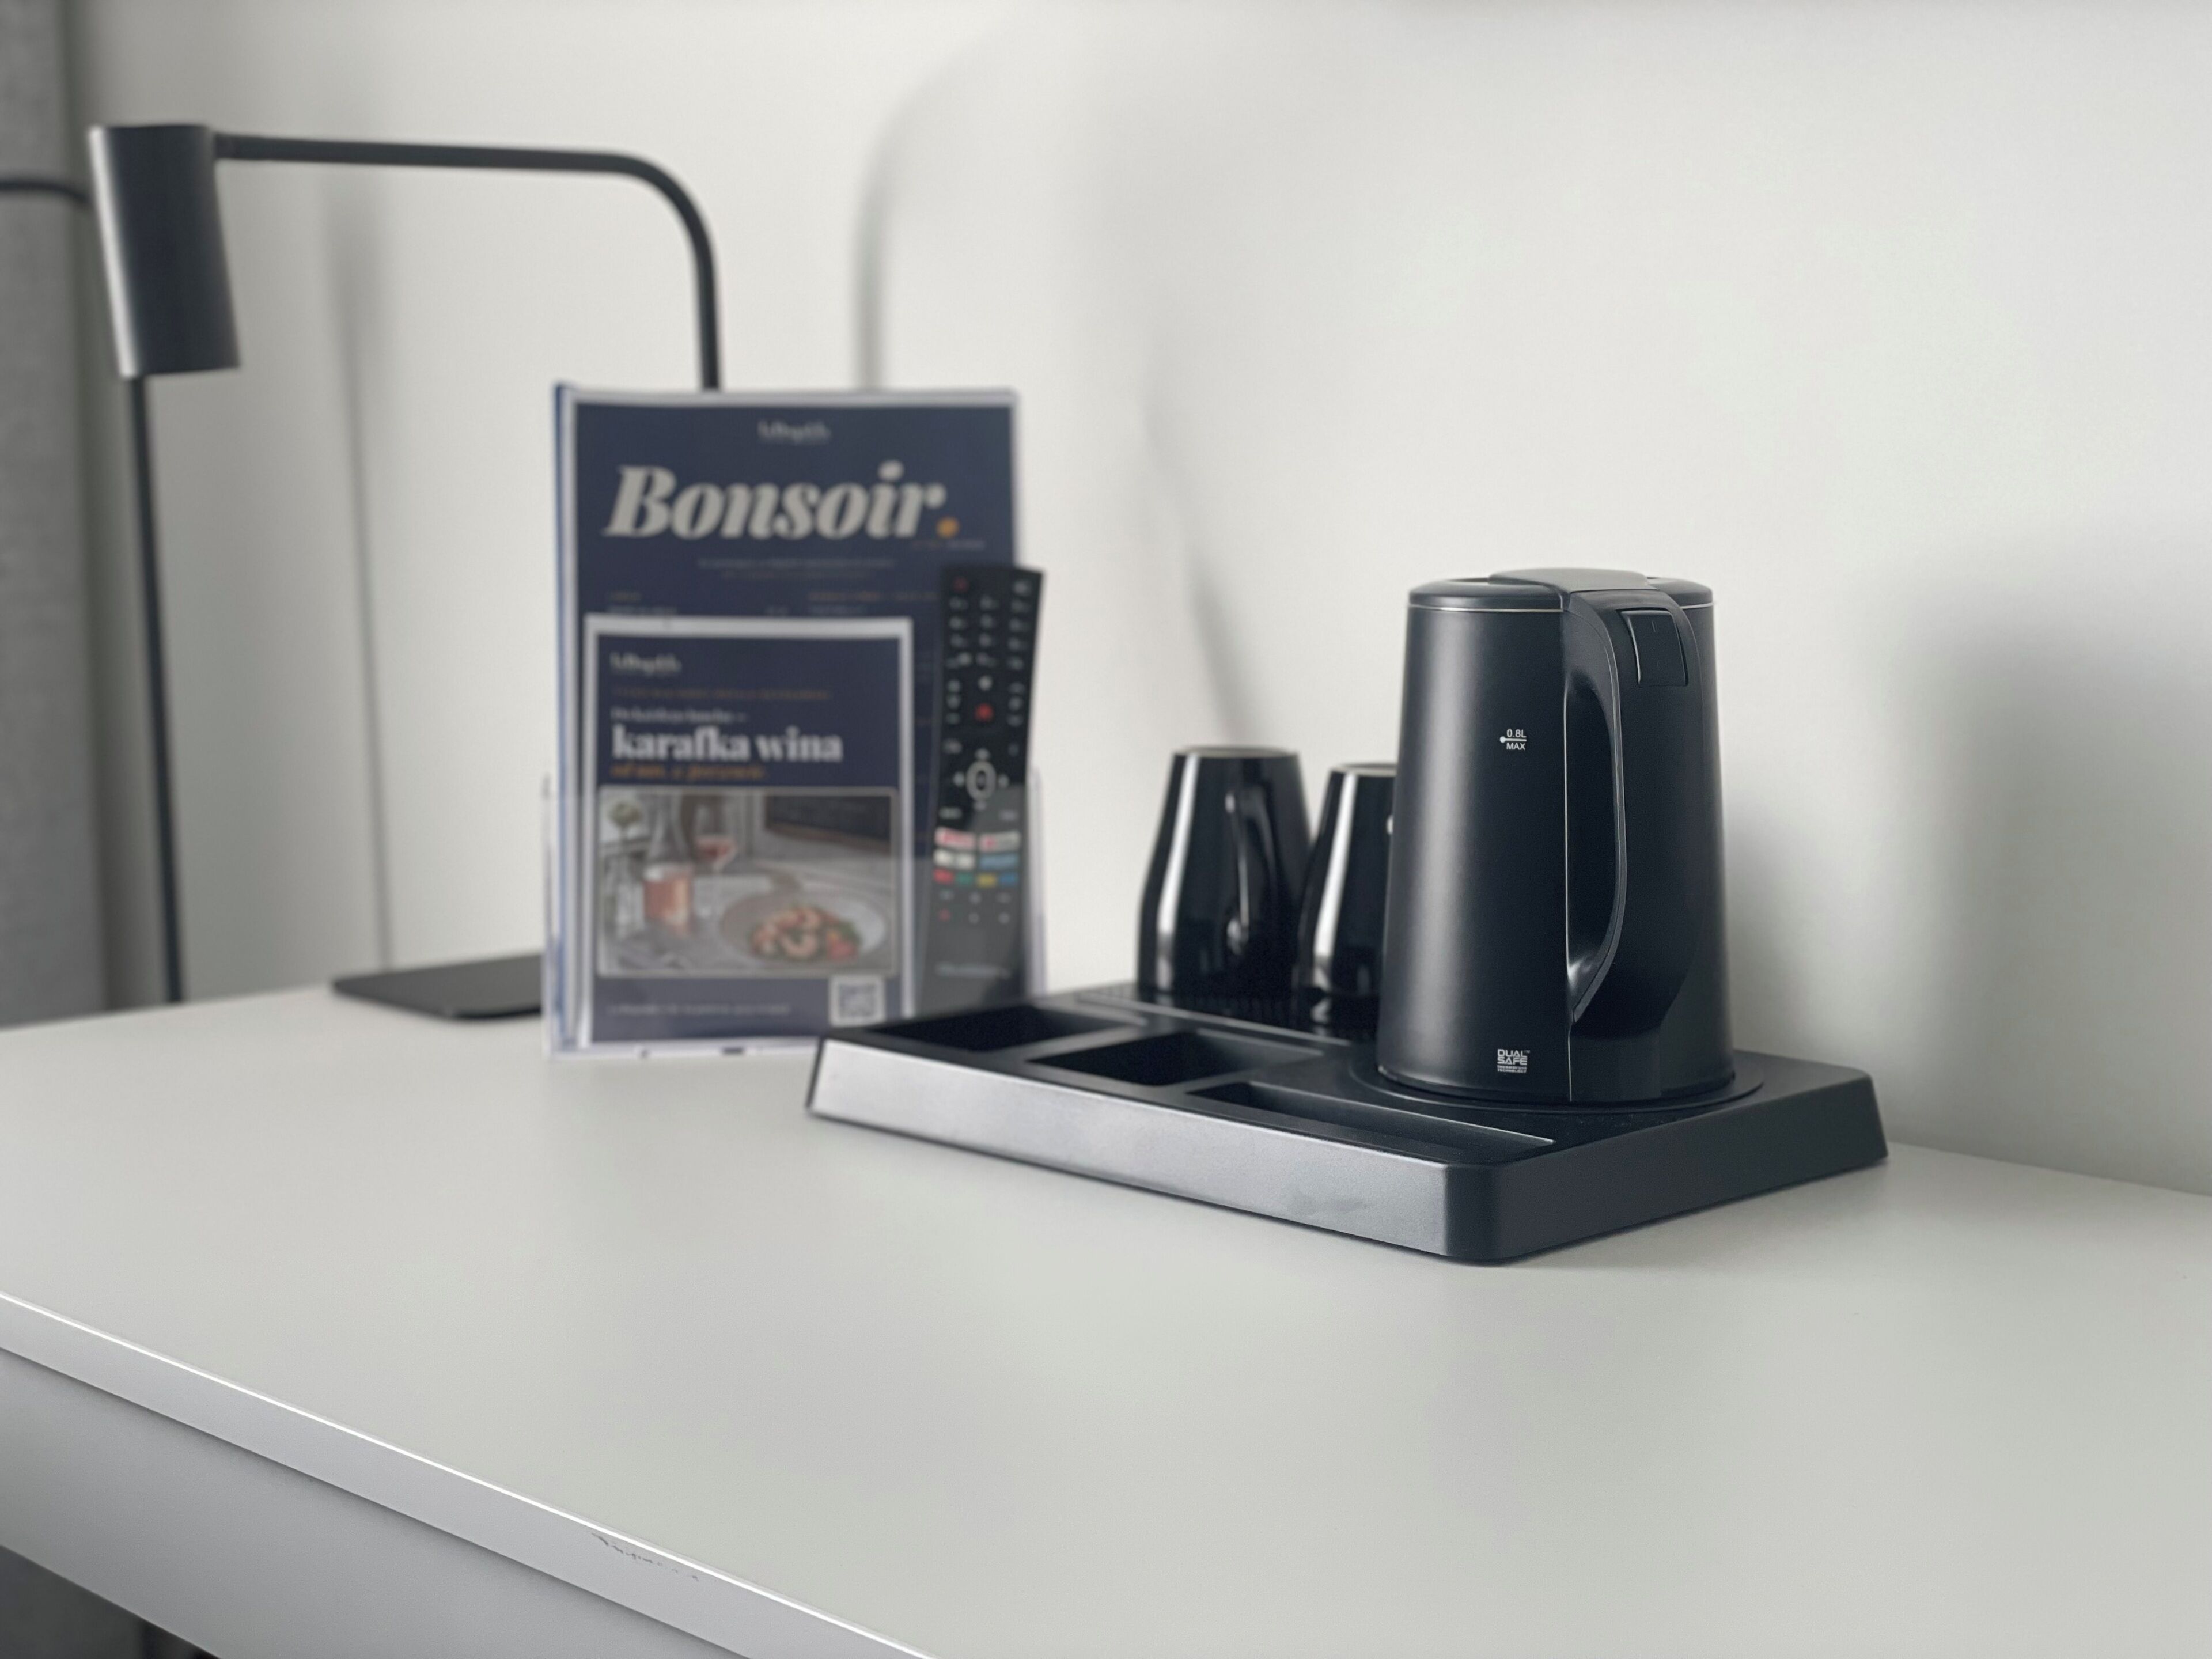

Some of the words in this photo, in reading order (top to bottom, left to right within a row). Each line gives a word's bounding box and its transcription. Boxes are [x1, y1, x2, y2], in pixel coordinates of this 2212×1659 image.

[603, 460, 959, 539] Bonsoir.
[1506, 729, 1527, 738] 0.8L
[612, 724, 749, 761] karafka
[756, 726, 843, 762] wina
[1506, 742, 1525, 750] MAX
[1497, 1056, 1528, 1065] SAFE
